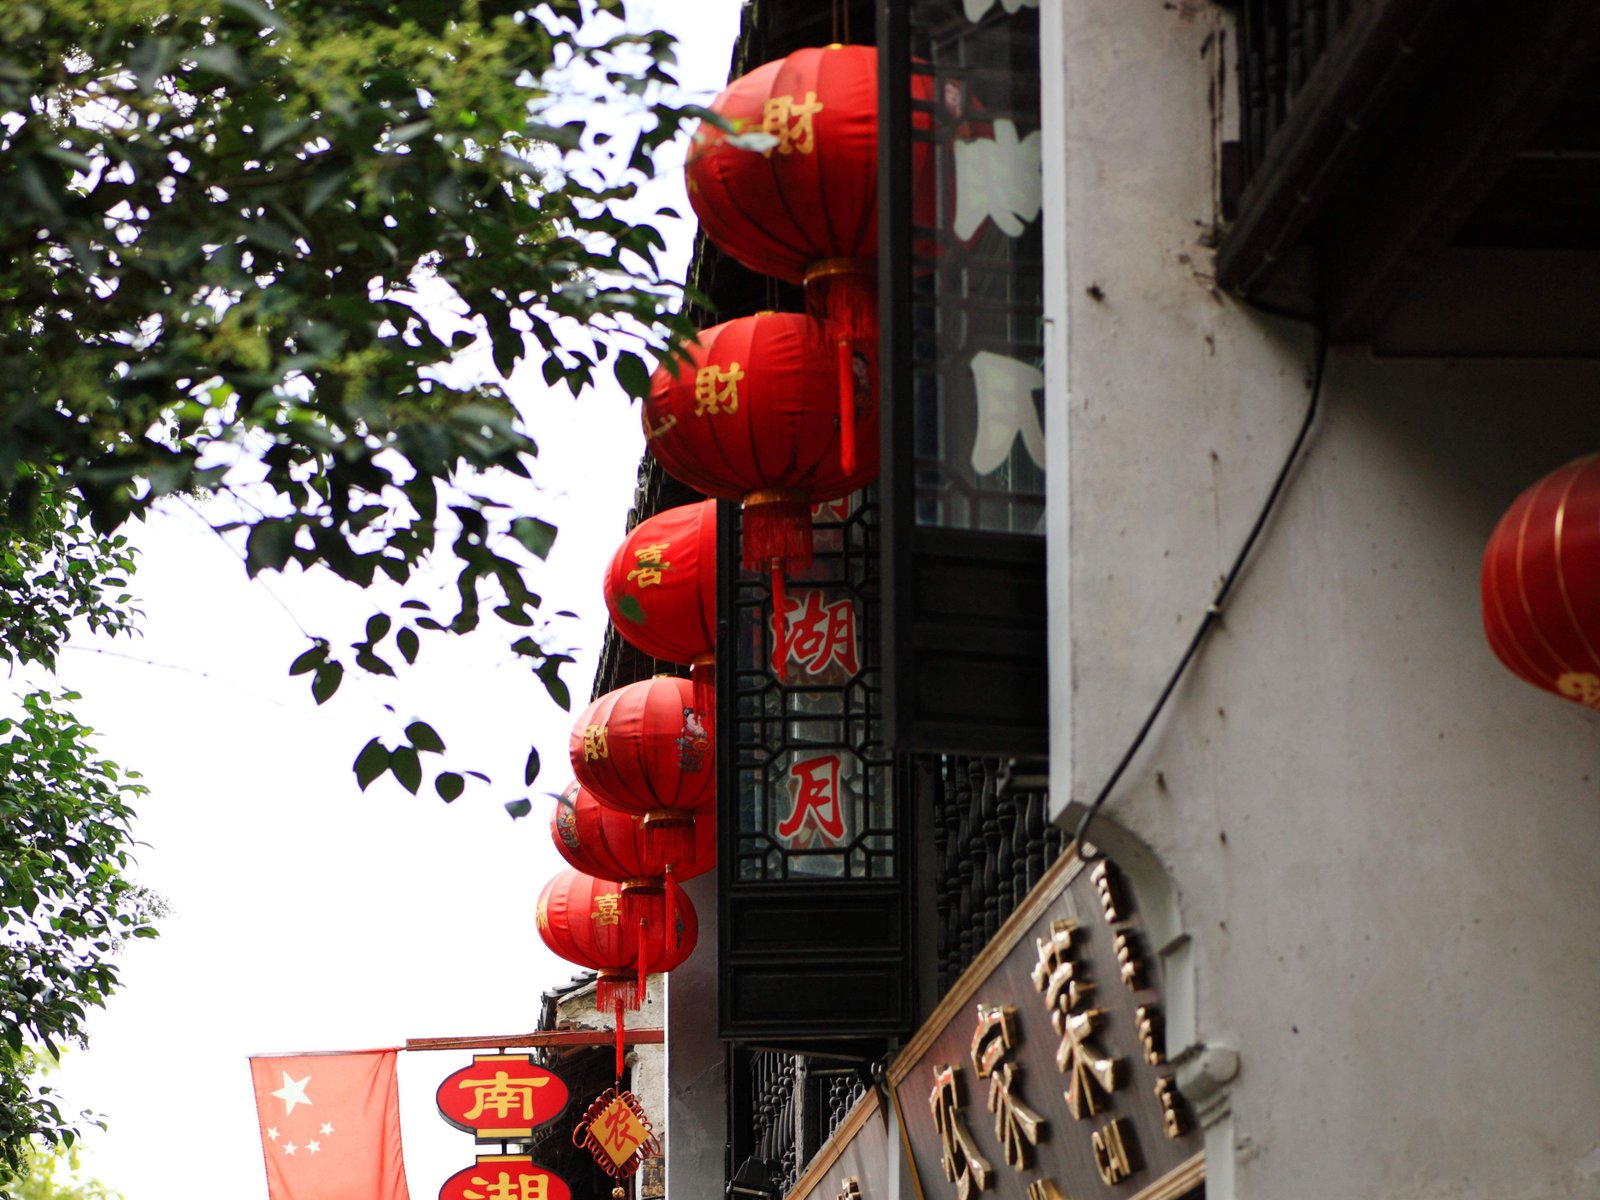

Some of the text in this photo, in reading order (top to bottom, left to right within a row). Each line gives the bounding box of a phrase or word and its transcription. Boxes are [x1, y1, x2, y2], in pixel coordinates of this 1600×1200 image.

[626, 542, 671, 590] 喜
[771, 496, 860, 842] 湖月
[1091, 1117, 1133, 1187] CAI
